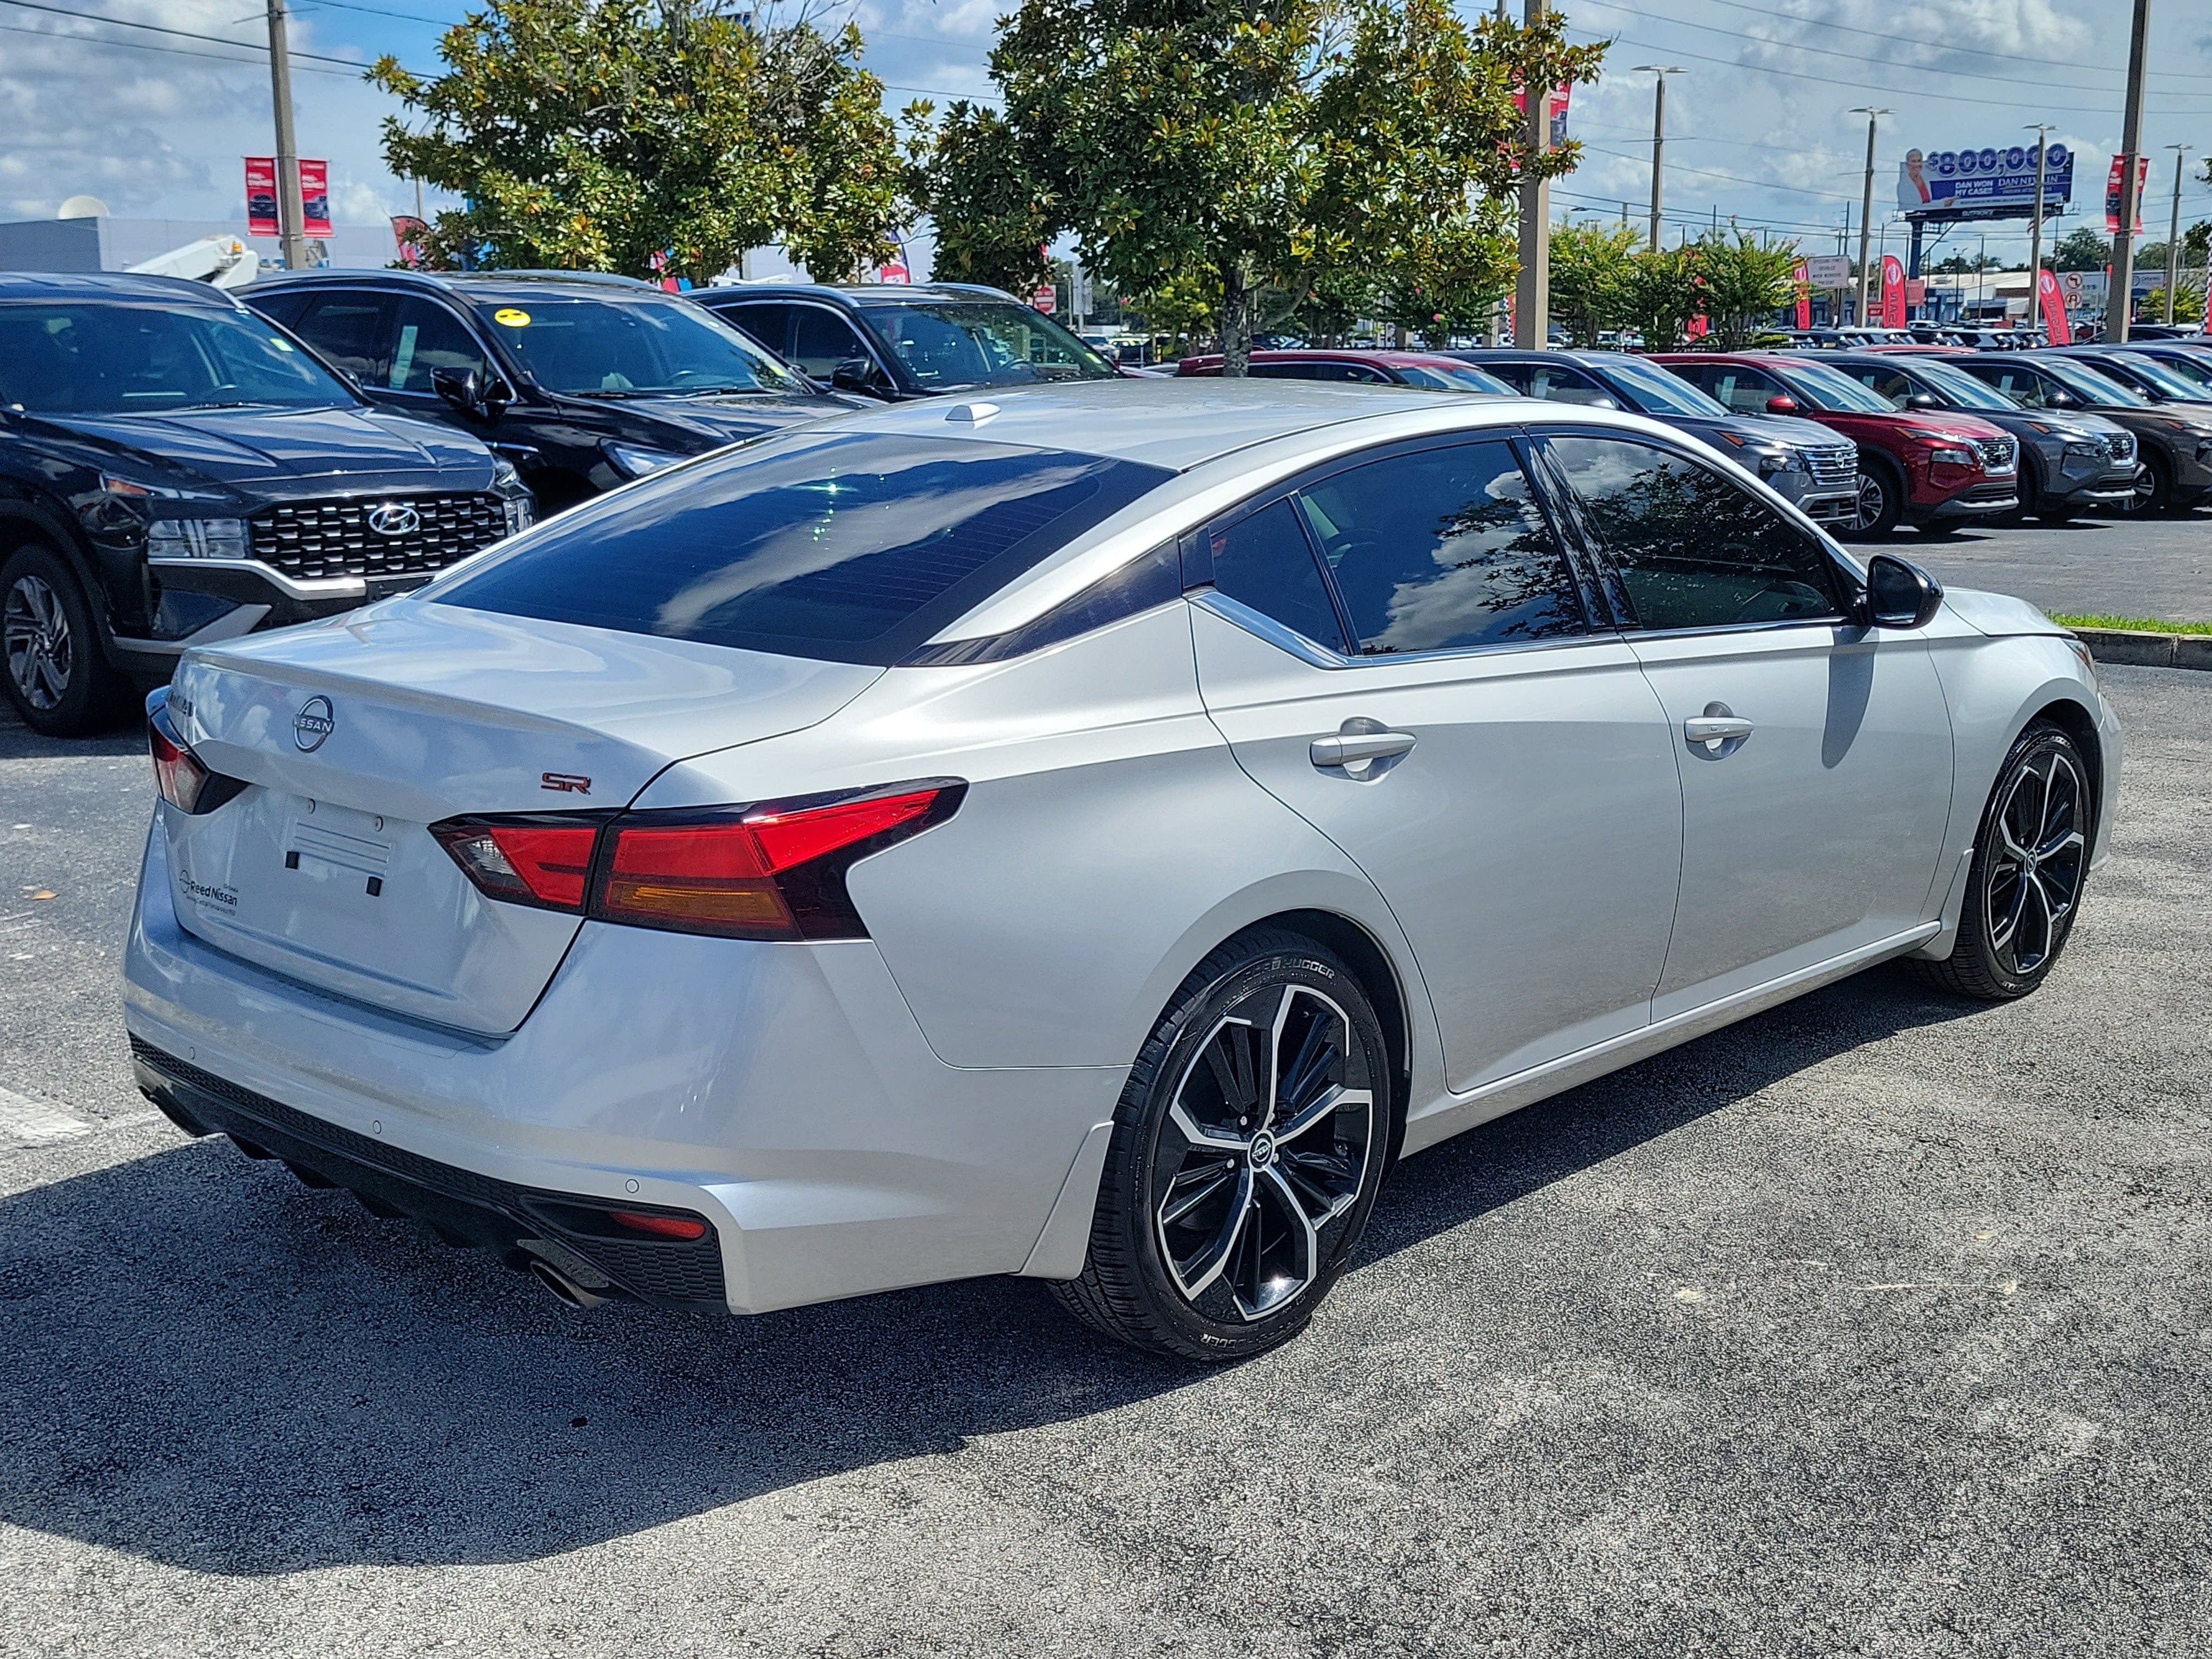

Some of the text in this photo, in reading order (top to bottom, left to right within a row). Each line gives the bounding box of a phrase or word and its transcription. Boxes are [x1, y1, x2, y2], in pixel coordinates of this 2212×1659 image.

[1955, 179, 1993, 189] DAN WON
[1998, 176, 2058, 187] DAN NEIN
[294, 718, 333, 732] SSAN
[541, 772, 591, 796] SR
[190, 881, 212, 897] Reed
[211, 887, 238, 907] Nissan
